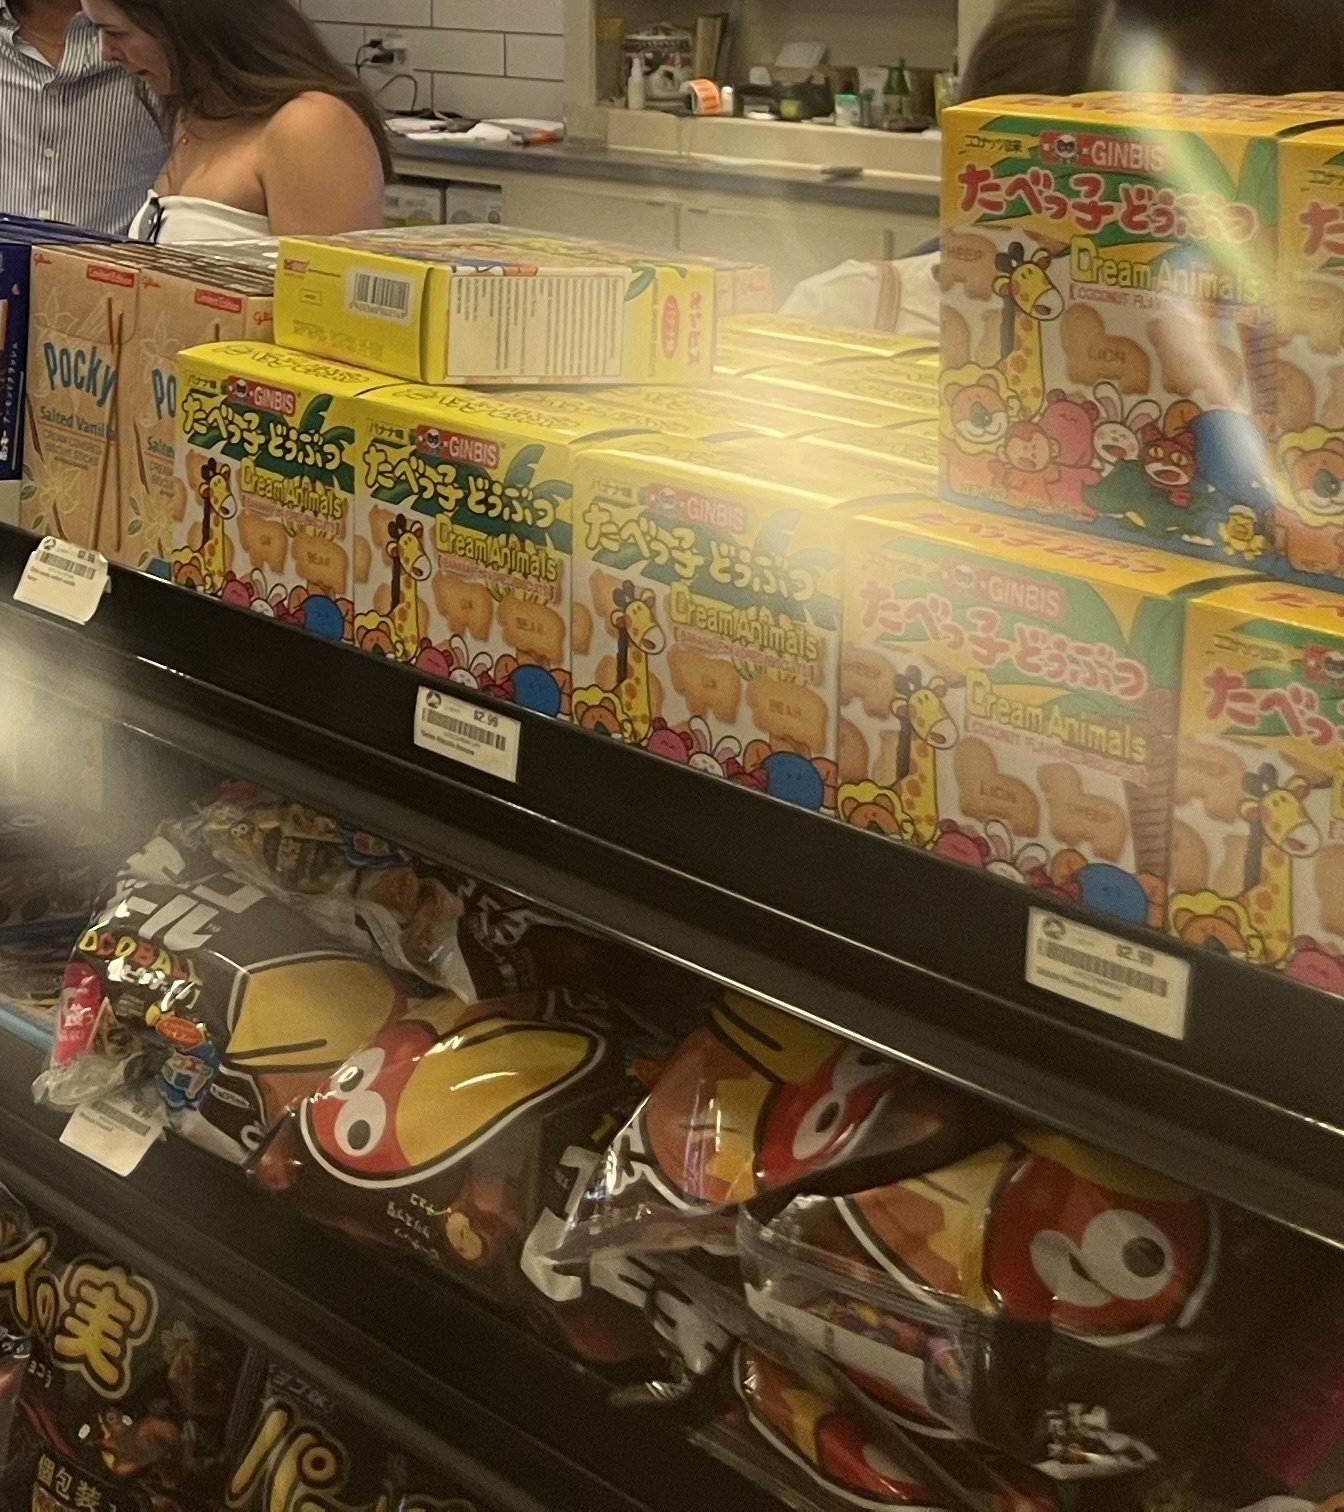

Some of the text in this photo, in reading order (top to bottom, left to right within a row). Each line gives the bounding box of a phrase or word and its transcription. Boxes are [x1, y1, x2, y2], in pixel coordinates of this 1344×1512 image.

[1089, 140, 1169, 173] GINBIS
[957, 162, 1260, 245] たべっ子どうぶつ
[1069, 235, 1153, 290] Dream
[40, 405, 74, 428] Salted
[180, 391, 343, 472] たべっ子どうぶつ
[253, 385, 295, 417] GINBIS
[448, 435, 499, 468] GINBIS
[240, 456, 288, 498] Dream
[286, 474, 345, 520] Animals
[363, 444, 557, 529] たべっ子どうぶつ
[686, 494, 746, 532] GINBIS
[434, 512, 490, 561] Dream
[488, 533, 559, 581] Animals
[581, 501, 816, 603] たべっ子どうぶつ
[670, 582, 736, 638] Dream
[734, 606, 819, 660] Animals
[987, 574, 1063, 617] GINBIS
[861, 579, 1150, 701] たべっ子どうぶつ
[964, 667, 1045, 731] Dream
[1047, 711, 1148, 765] Animals
